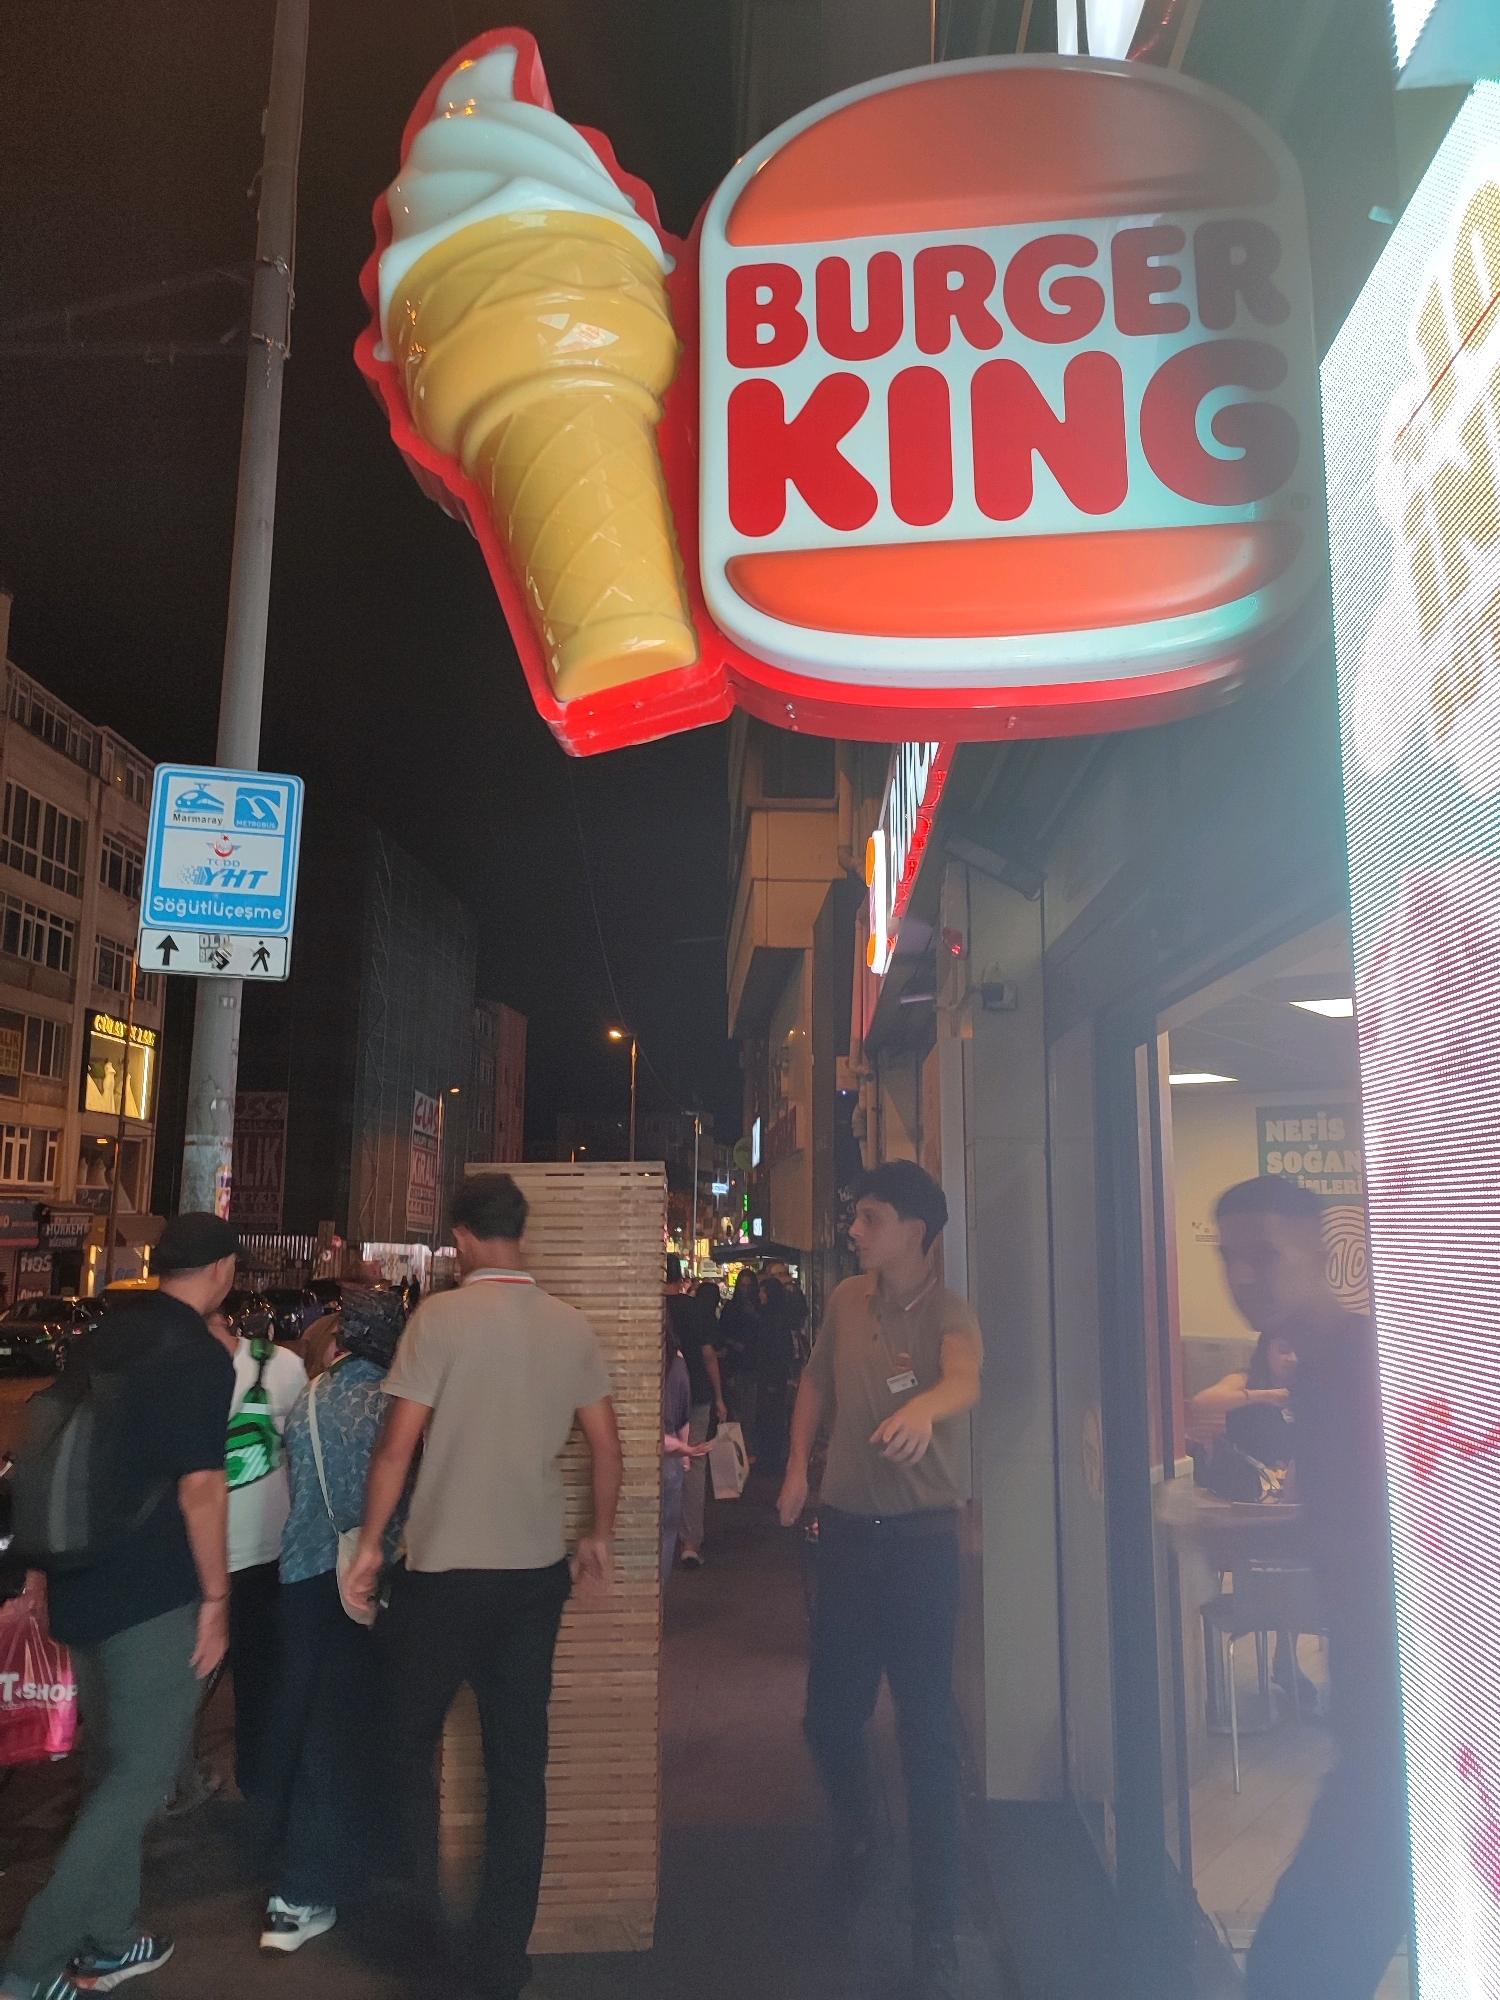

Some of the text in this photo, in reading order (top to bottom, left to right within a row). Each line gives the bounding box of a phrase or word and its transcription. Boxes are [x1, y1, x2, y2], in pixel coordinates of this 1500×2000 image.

[726, 219, 1291, 369] BURGER
[727, 339, 1300, 538] KING
[173, 813, 223, 826] Marmaray
[204, 866, 269, 889] YHT
[153, 896, 283, 920] Söğütlüçeşme
[1265, 1111, 1346, 1142] NEFİS
[1266, 1144, 1362, 1174] SOĞAN
